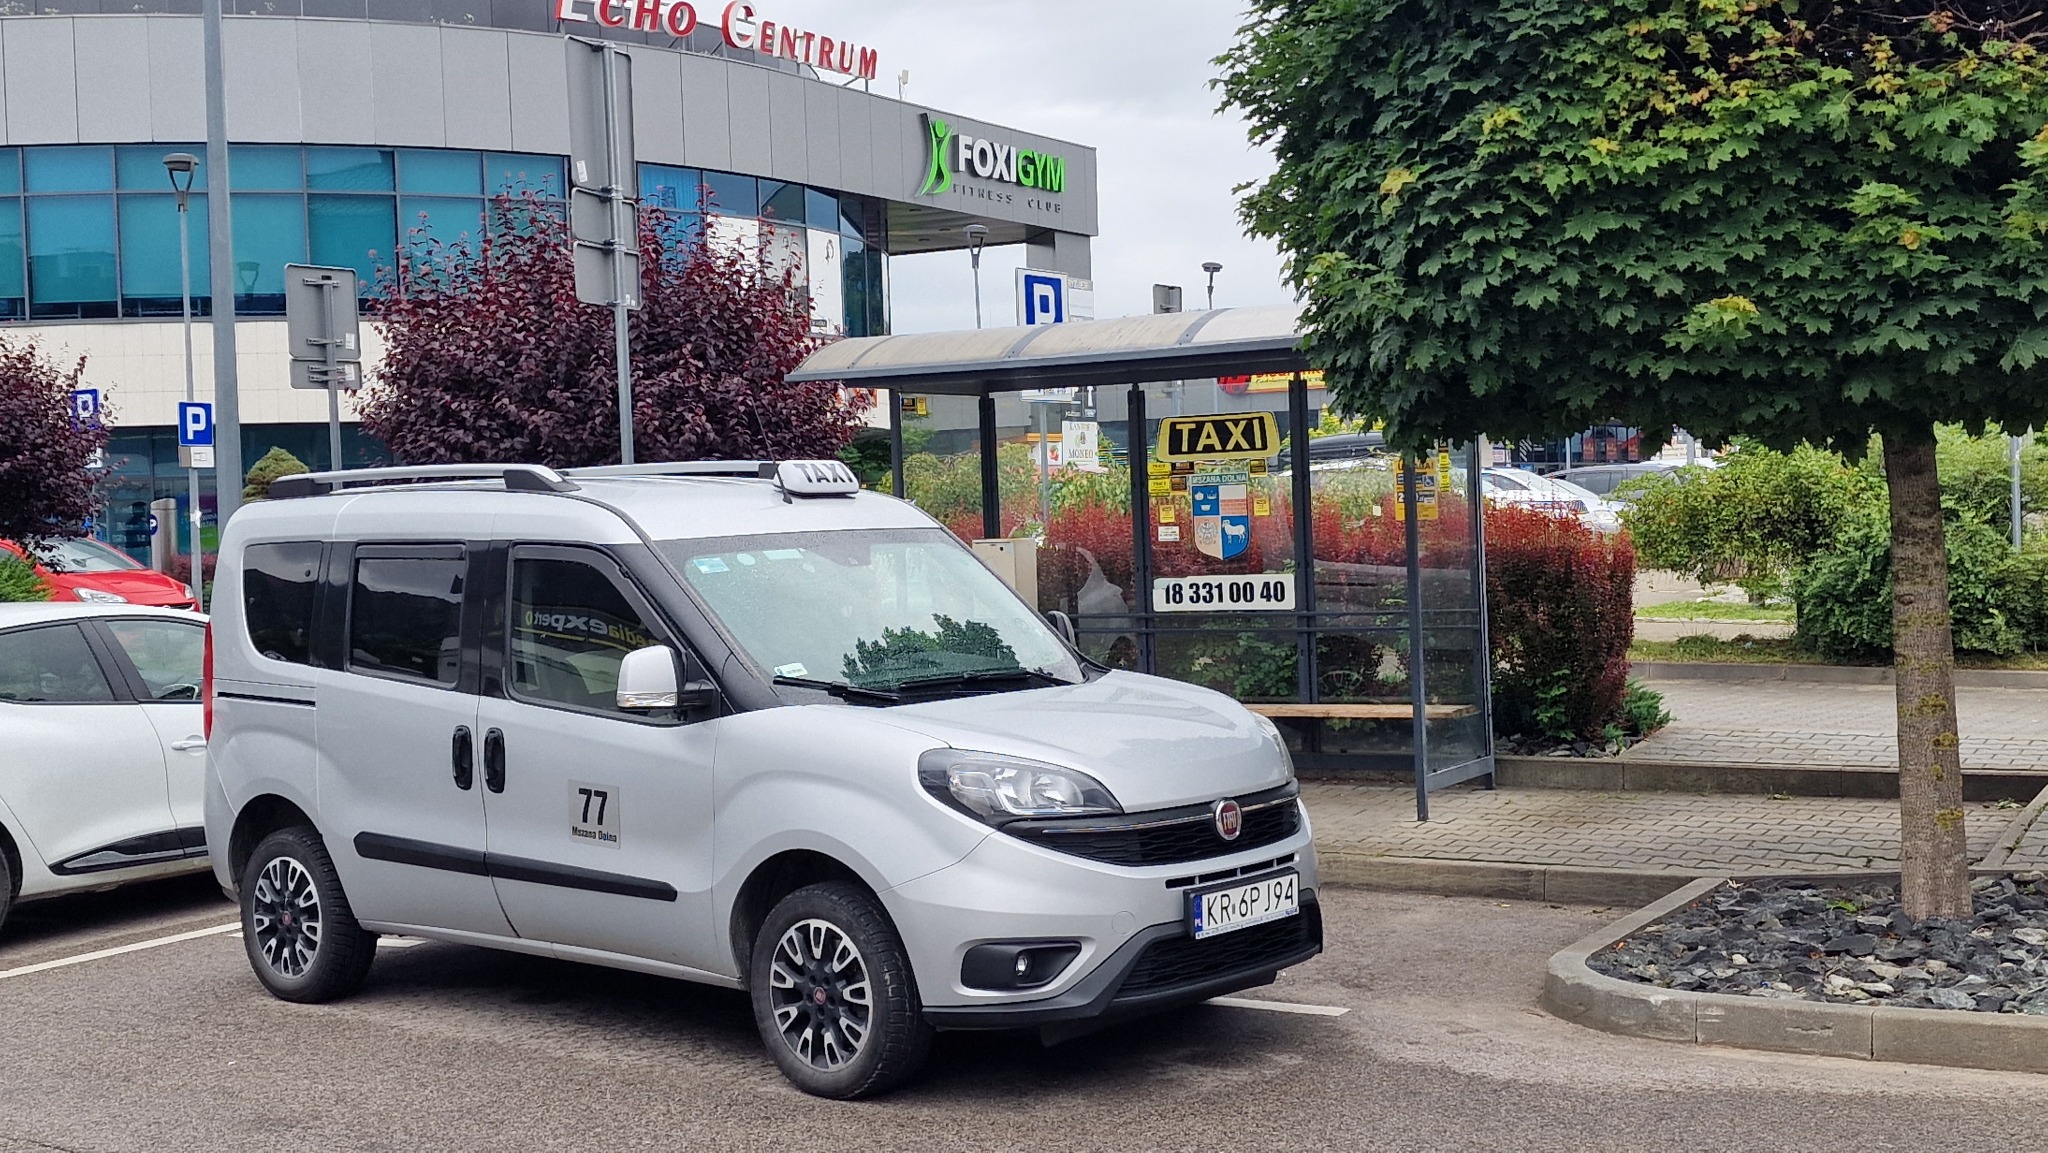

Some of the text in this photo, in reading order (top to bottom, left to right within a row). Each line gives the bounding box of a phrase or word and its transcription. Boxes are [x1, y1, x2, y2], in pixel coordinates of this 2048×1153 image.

[721, 0, 878, 80] CENTRUM
[956, 134, 1066, 193] FOXIGYM
[952, 184, 1062, 213] FITNESS CLUB
[1033, 283, 1055, 323] P
[186, 407, 207, 440] P
[1175, 418, 1263, 452] TAXI
[793, 463, 854, 483] TAXI
[1222, 473, 1247, 482] DOLNA
[1165, 580, 1286, 605] 18 331 00 40
[578, 787, 608, 826] 77
[571, 825, 617, 843] Mszana Dolna
[1207, 893, 1231, 927] KR
[1239, 877, 1294, 918] 6PJ94
